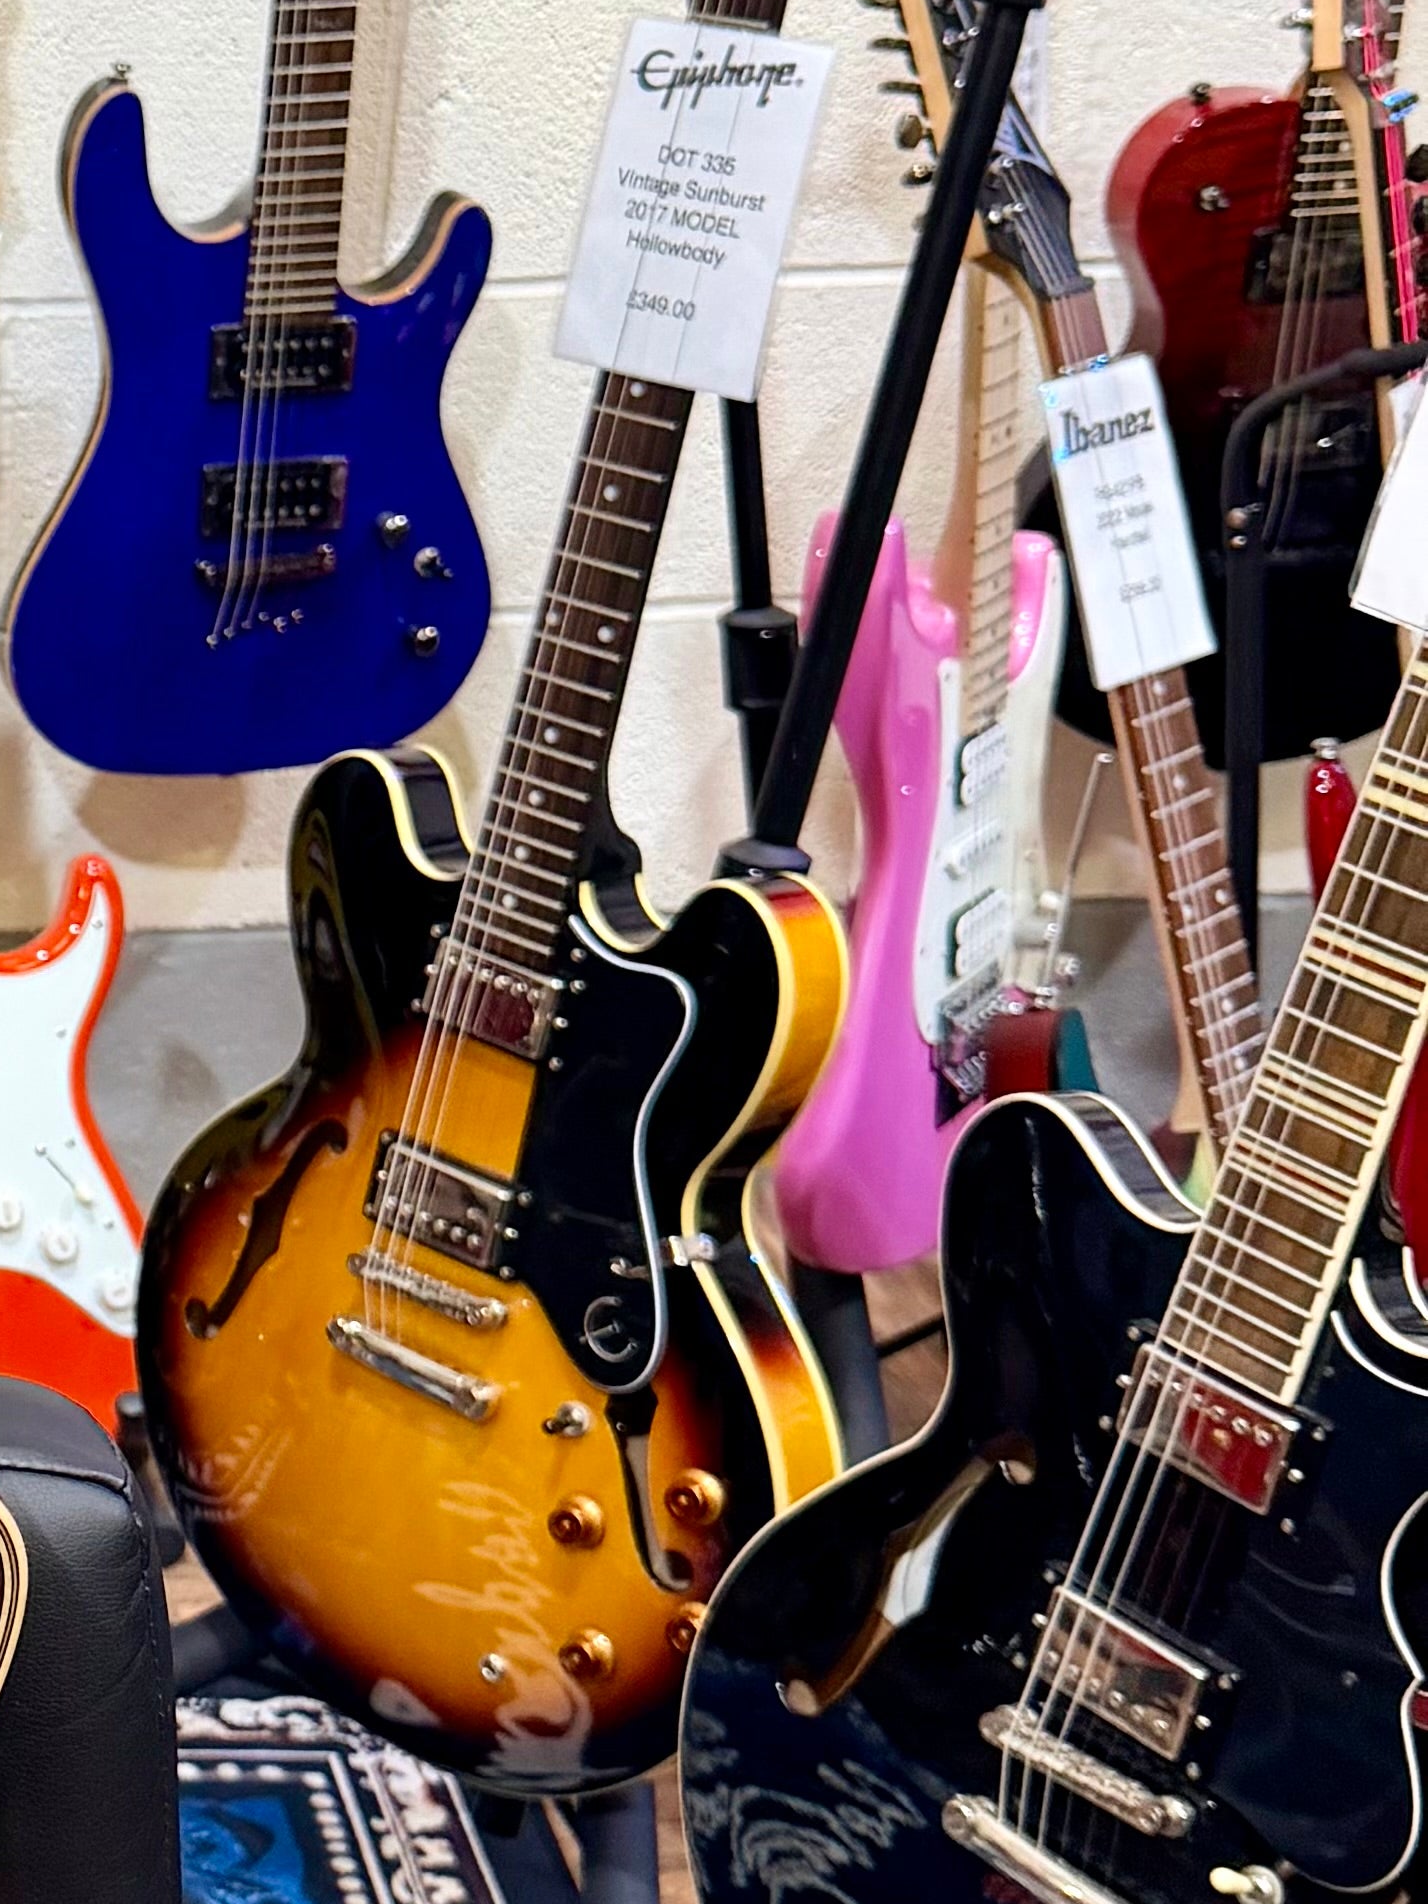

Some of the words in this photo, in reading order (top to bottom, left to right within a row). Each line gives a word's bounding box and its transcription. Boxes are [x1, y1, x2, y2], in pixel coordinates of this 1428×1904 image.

[658, 144, 698, 169] DOT
[701, 150, 736, 177] 335
[617, 167, 682, 200] Vintage
[683, 178, 766, 213] Sunburst
[624, 198, 668, 224] 2017
[669, 207, 741, 240] MODEL
[625, 228, 726, 269] Hollowbody
[1059, 406, 1156, 456] Ibanez
